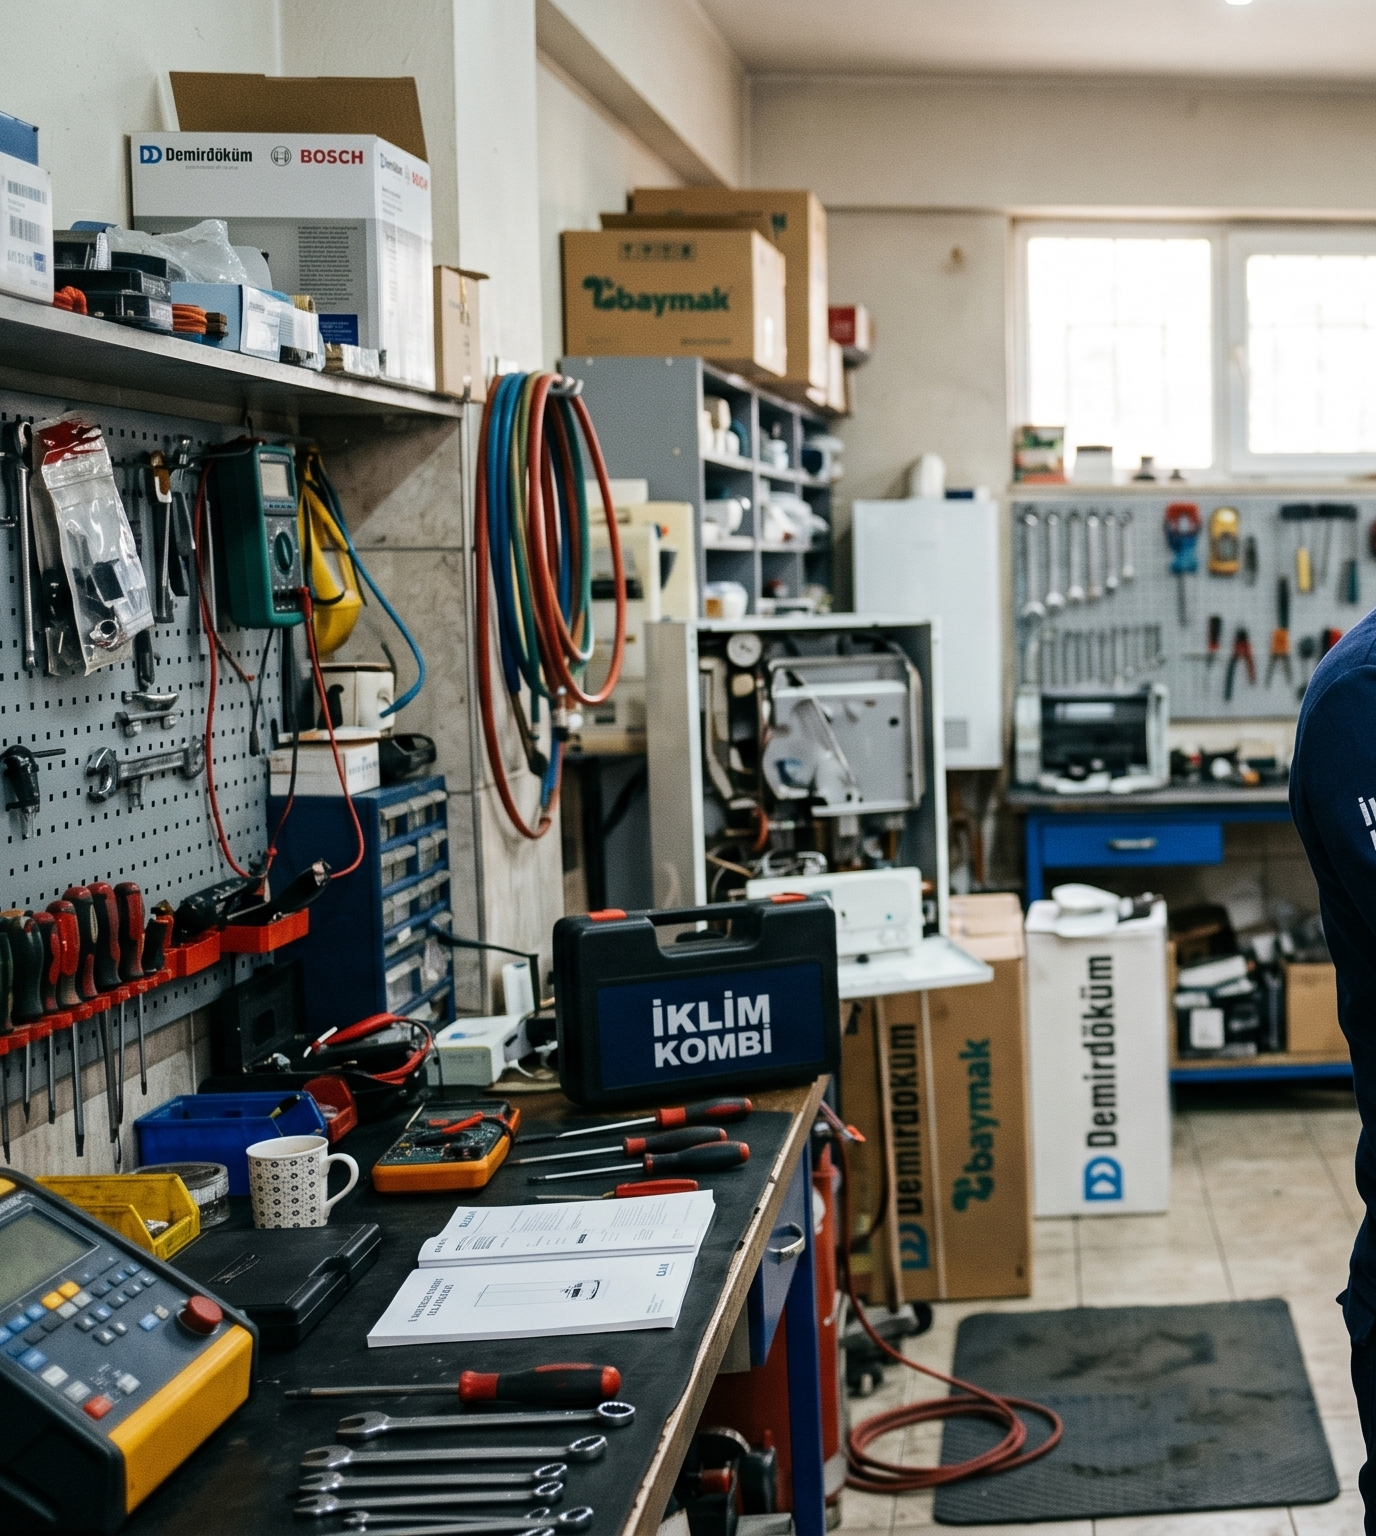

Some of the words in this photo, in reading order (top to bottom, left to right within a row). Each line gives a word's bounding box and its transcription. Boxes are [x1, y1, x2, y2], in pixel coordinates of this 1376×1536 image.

[300, 149, 364, 165] BOSCH
[652, 990, 771, 1037] İKLİM
[654, 1023, 773, 1068] KOMBİ
[1080, 955, 1118, 1148] Demirdöküm
